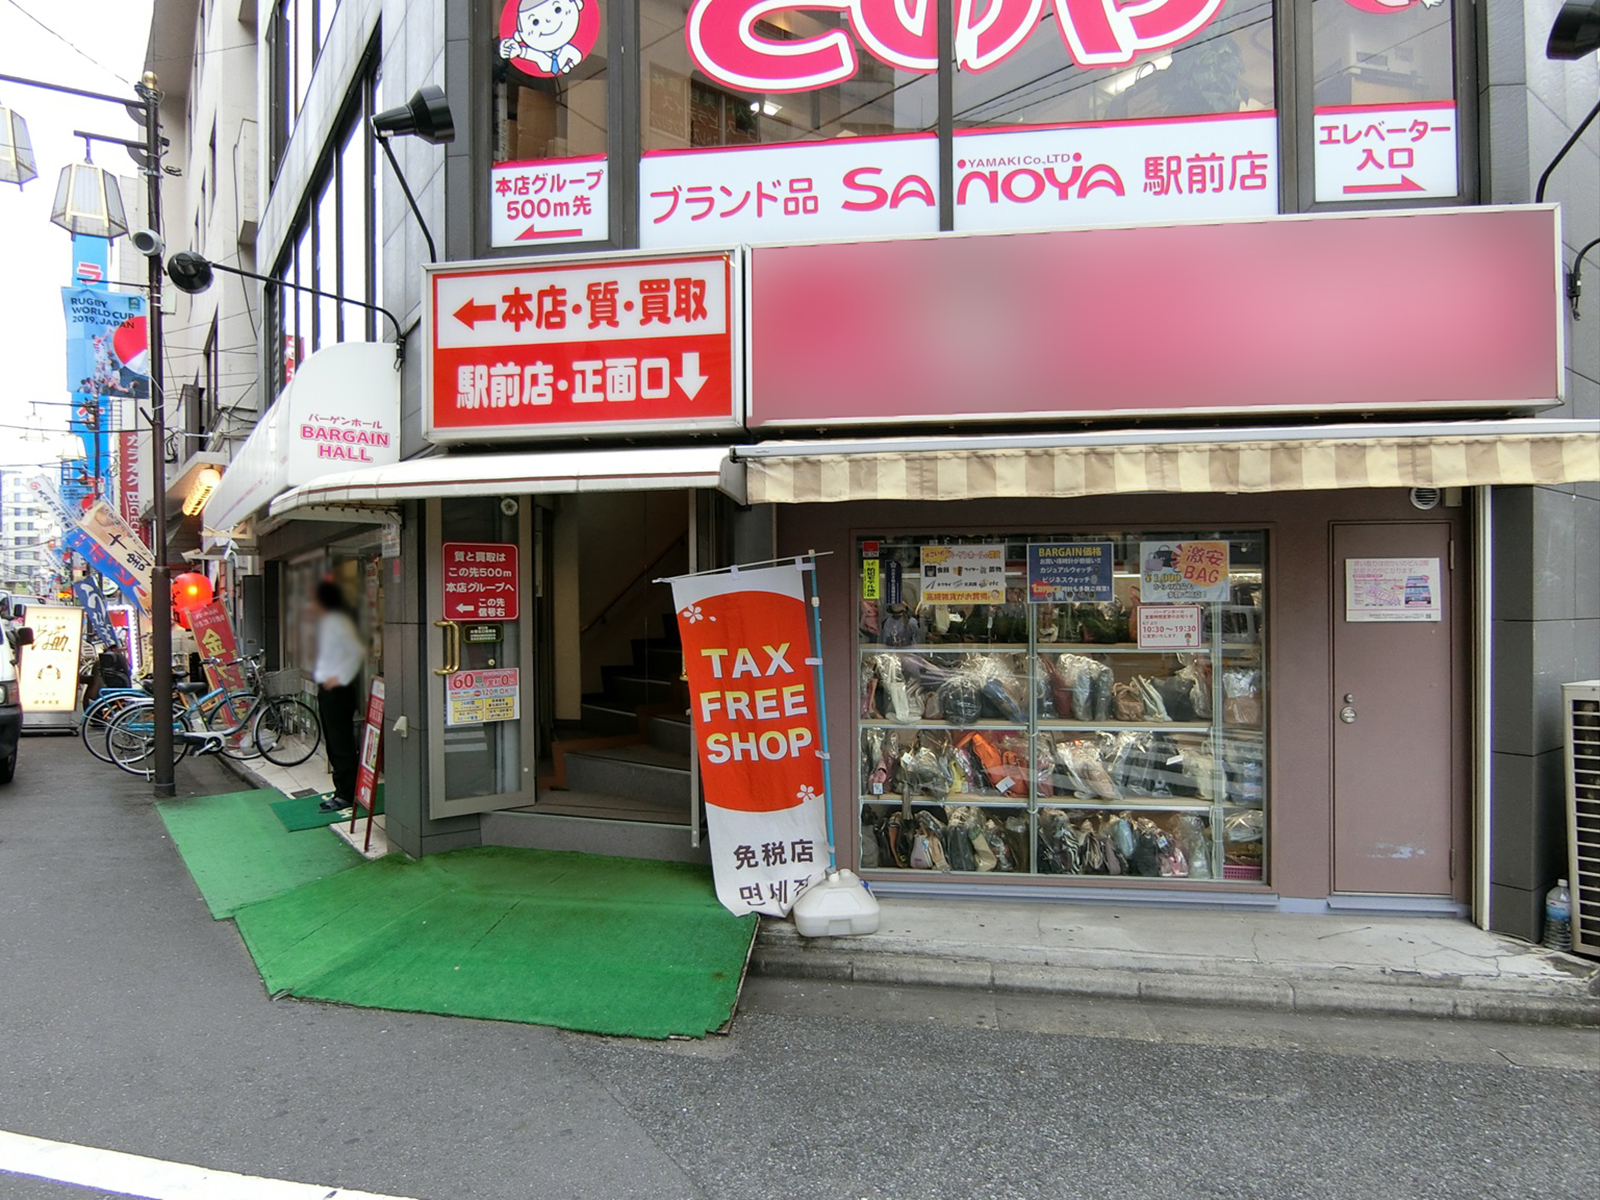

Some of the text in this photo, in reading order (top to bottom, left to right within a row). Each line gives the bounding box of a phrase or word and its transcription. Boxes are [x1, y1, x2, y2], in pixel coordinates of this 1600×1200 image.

[1320, 120, 1451, 145] エレベーター
[968, 157, 1021, 169] YAMAKI
[1356, 147, 1415, 171] 入口
[495, 169, 605, 197] 本店グループ
[650, 178, 819, 224] ブランド品
[1143, 151, 1268, 196] 駅前店
[506, 196, 592, 220] 500m先
[70, 297, 108, 309] RUGBY
[501, 277, 708, 333] 本店・質・買取
[72, 306, 135, 321] WORLD CUP
[100, 317, 136, 330] JAPAN
[456, 357, 671, 410] 駅前店・正面口
[308, 413, 383, 430] バーゲンホール
[301, 425, 389, 447] BARGAIN
[319, 444, 372, 463] HALL
[454, 550, 507, 563] 質と買取は
[1038, 546, 1102, 558] BARGAIN価格
[1186, 545, 1224, 567] 激安
[448, 566, 512, 578] この先500m
[1039, 566, 1093, 574] カジュアルウォッチ
[1183, 565, 1220, 584] BAG
[445, 581, 515, 594] 本店グループへ
[1042, 576, 1090, 584] ビジネスウォッチ
[478, 597, 506, 608] この先
[478, 607, 506, 617] 信号右
[700, 642, 795, 679] TAX
[699, 683, 809, 723] FREE
[705, 726, 813, 765] SHOP
[733, 838, 814, 871] 免税店
